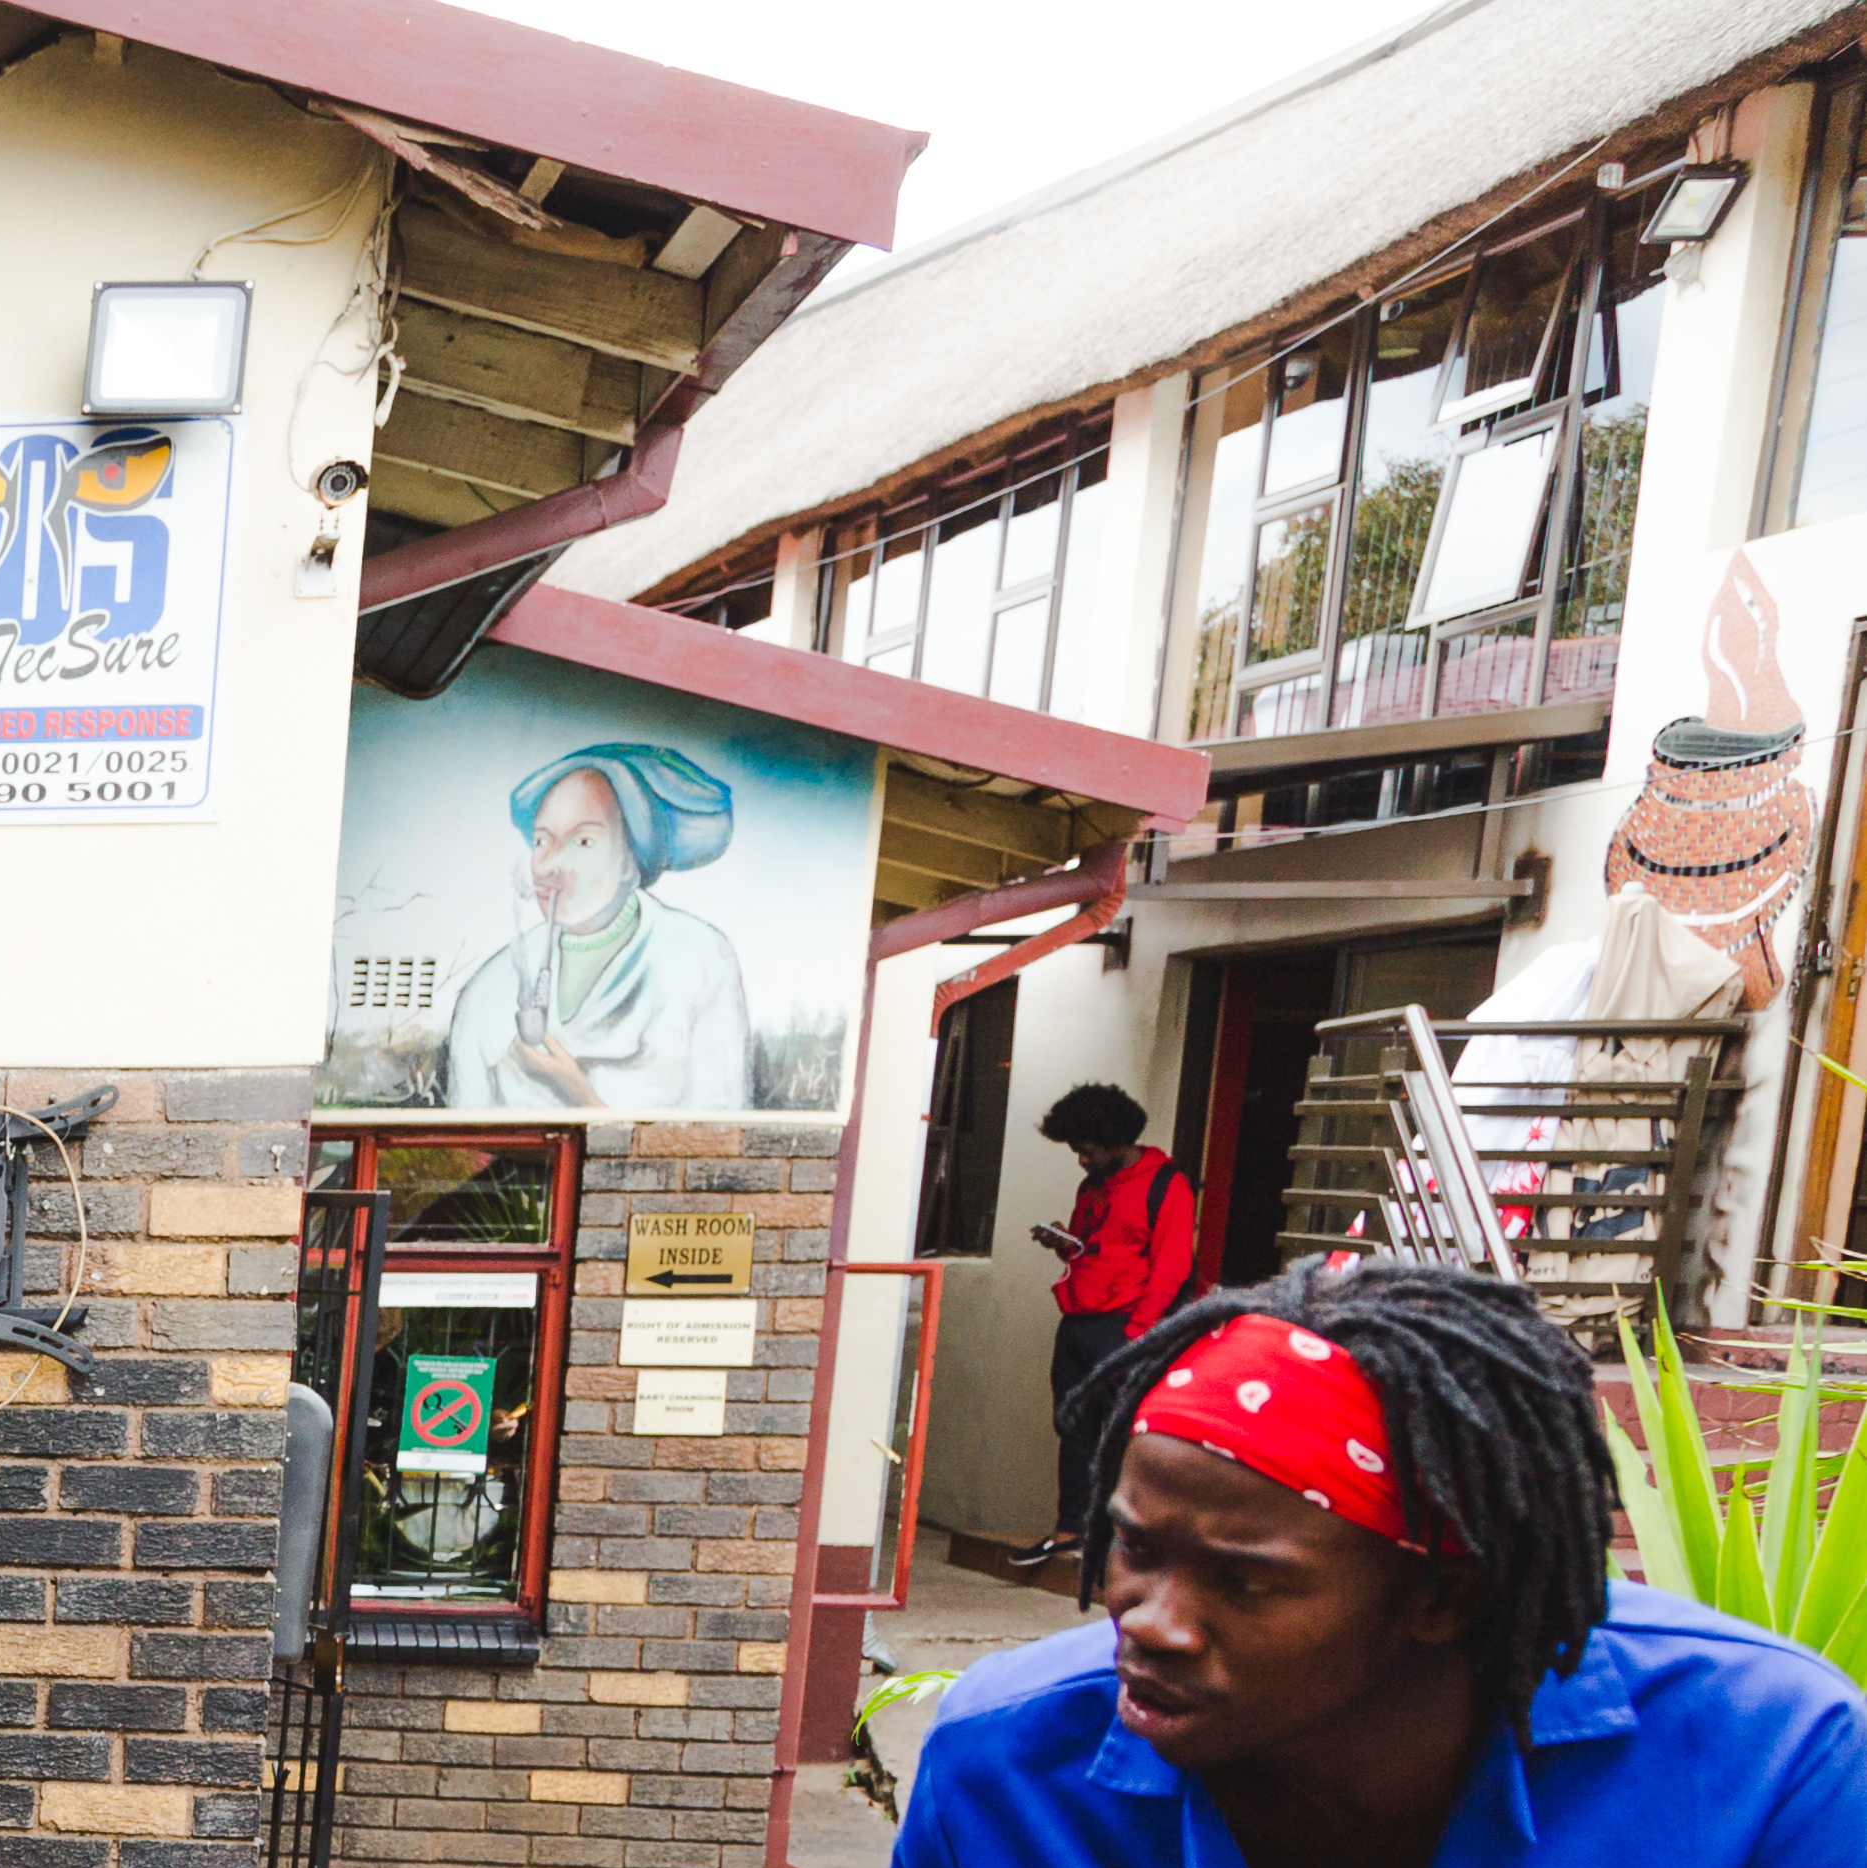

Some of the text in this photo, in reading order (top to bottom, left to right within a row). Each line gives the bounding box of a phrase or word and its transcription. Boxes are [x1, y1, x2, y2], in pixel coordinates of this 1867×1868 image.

[44, 708, 192, 739] RESPONSE
[67, 780, 177, 802] 5001
[634, 1218, 752, 1236] WASH ROOM
[659, 1248, 723, 1265] INSIDE
[626, 1322, 751, 1330] RIGHT OF ADMISSION
[656, 1336, 718, 1344] RESERVED
[669, 1394, 723, 1402] CHANGING
